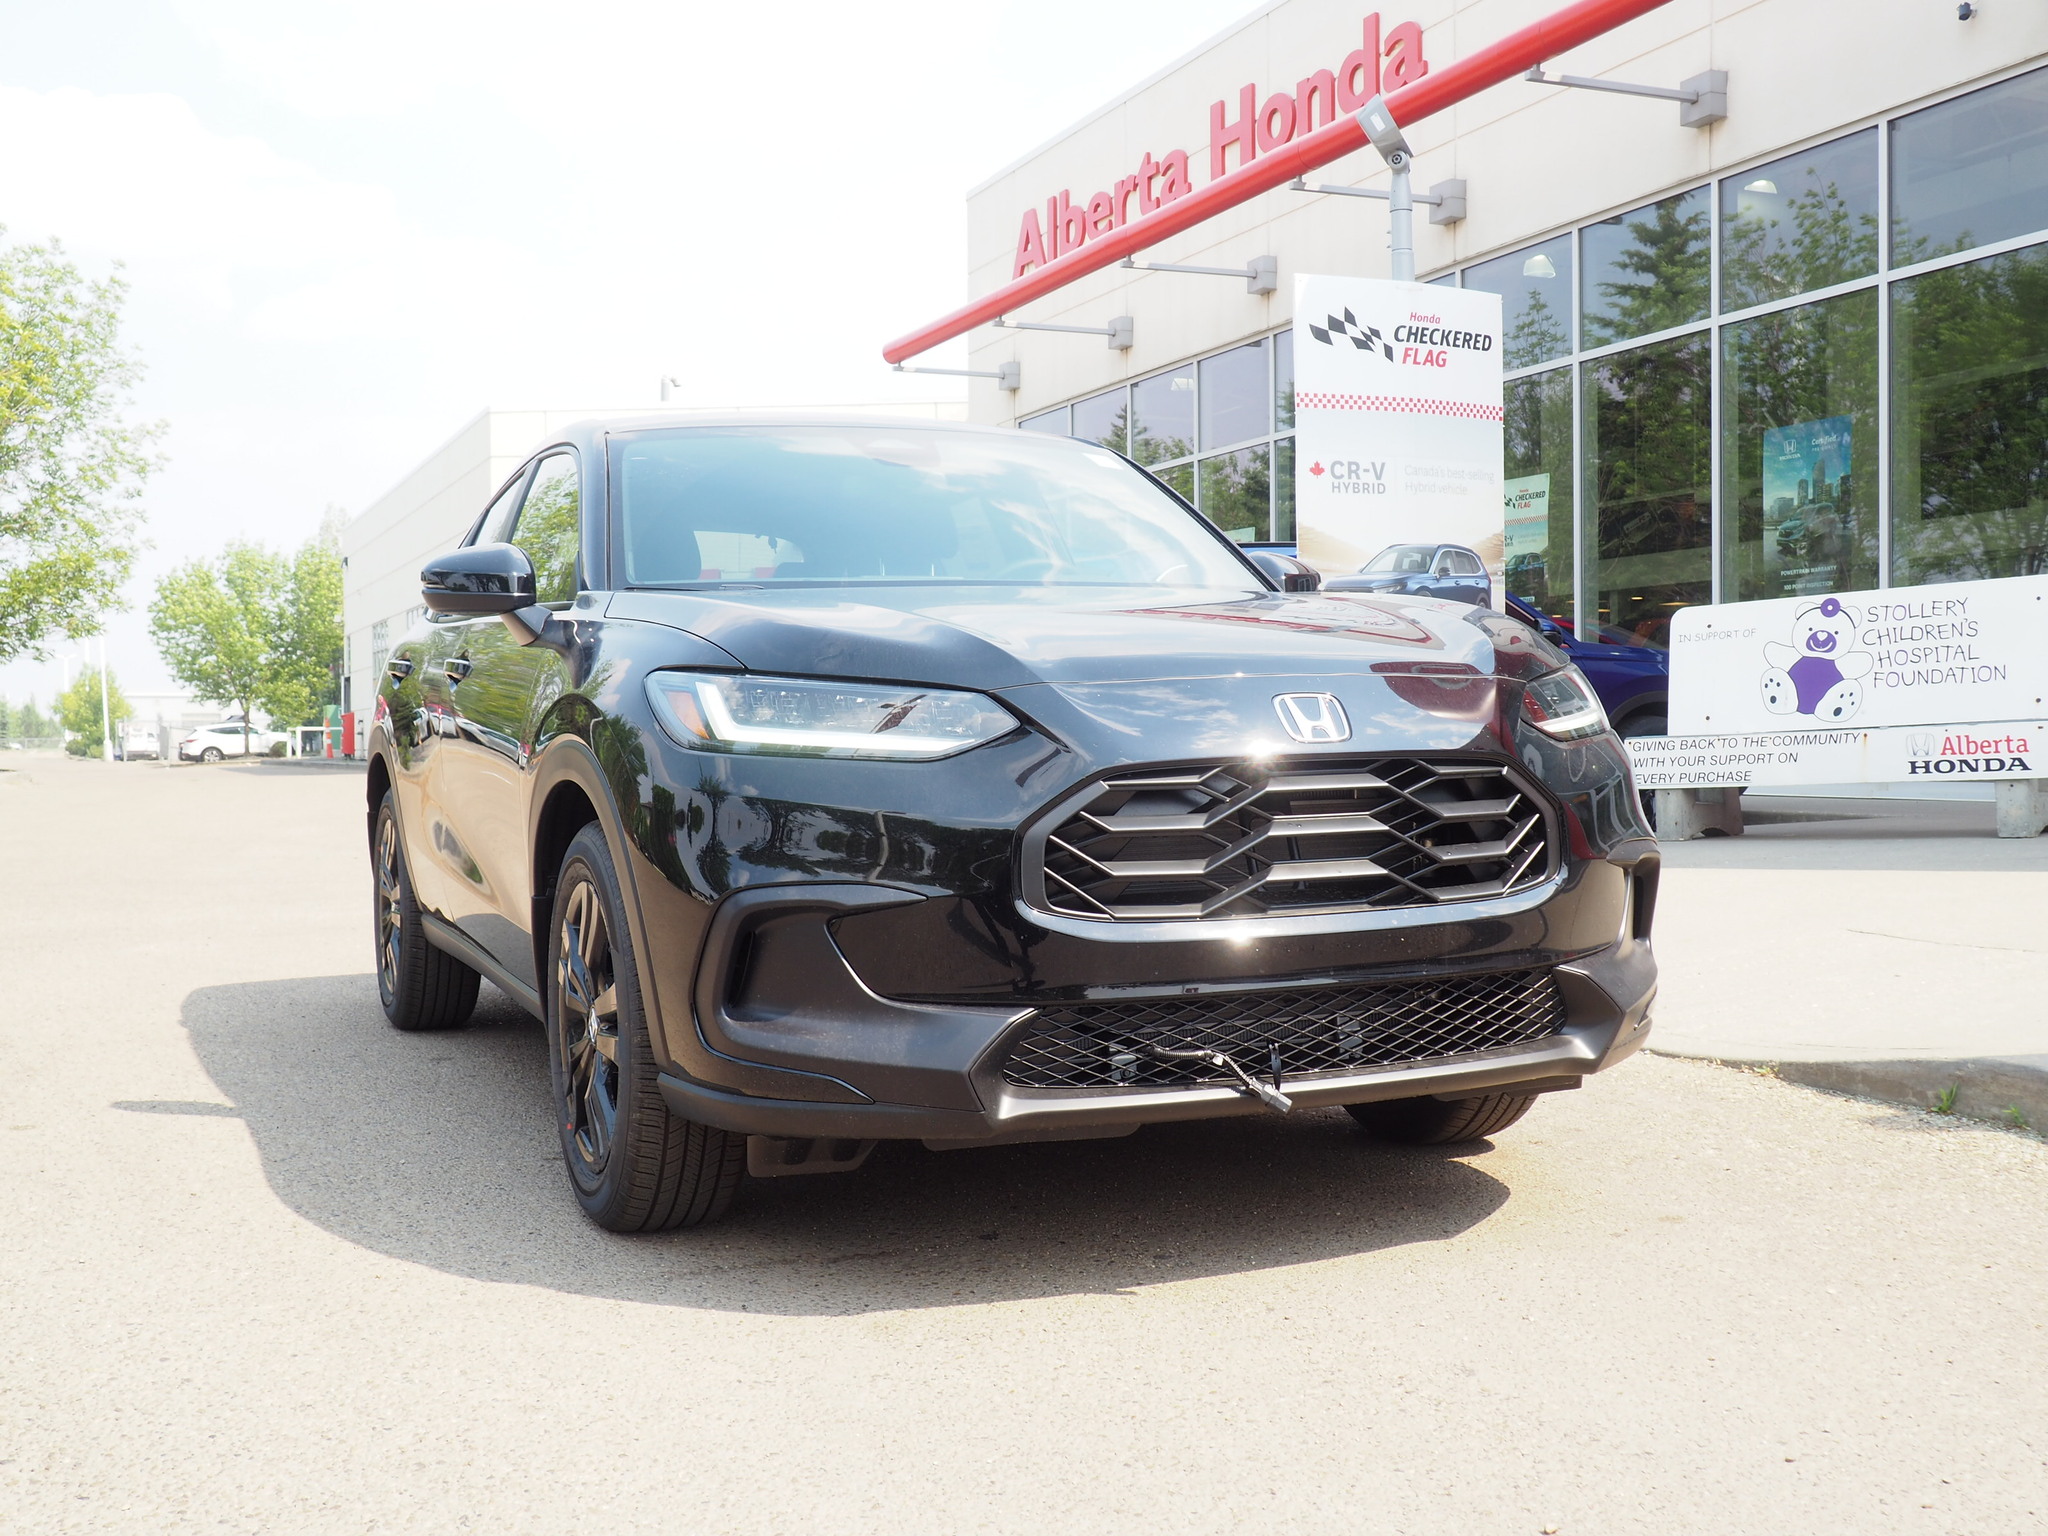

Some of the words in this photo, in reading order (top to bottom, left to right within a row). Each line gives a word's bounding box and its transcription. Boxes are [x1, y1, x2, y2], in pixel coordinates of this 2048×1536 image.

[1012, 150, 1192, 280] Alberta
[1210, 12, 1429, 180] Honda
[1409, 311, 1441, 325] Honda
[1393, 324, 1493, 352] CHECKERED
[1402, 347, 1448, 368] FLAG
[1330, 460, 1386, 481] CR-V
[1404, 464, 1445, 478] Canada's
[1331, 481, 1386, 495] HYBRID
[1404, 481, 1437, 495] Hybrid
[1515, 490, 1546, 502] CHECKERED
[1517, 501, 1532, 510] FLAG
[1780, 567, 1810, 577] POWERTRAIN
[1811, 565, 1837, 574] WARRANTY
[1867, 597, 1968, 623] STOLLERY
[1679, 634, 1691, 643] IN
[1694, 629, 1739, 642] SUPPORT
[1742, 628, 1756, 638] OF
[1862, 618, 1979, 646] CHILDREN'S
[1877, 644, 1980, 668] HOSPITAL
[1873, 664, 2007, 689] FOUNDATION
[1632, 739, 1676, 753] GIVING
[1680, 738, 1716, 751] BACK
[1721, 737, 1738, 749] TO
[1743, 736, 1768, 748] THE
[1772, 732, 1861, 747] COMMUNITY
[1940, 734, 2030, 756] Alberta
[1634, 756, 1666, 768] WITH
[1669, 755, 1706, 767] YOUR
[1709, 752, 1774, 766] SUPPORT
[1777, 752, 1798, 764] ON
[1908, 757, 2033, 775] HONDA
[1679, 770, 1753, 783] PURCHASE
